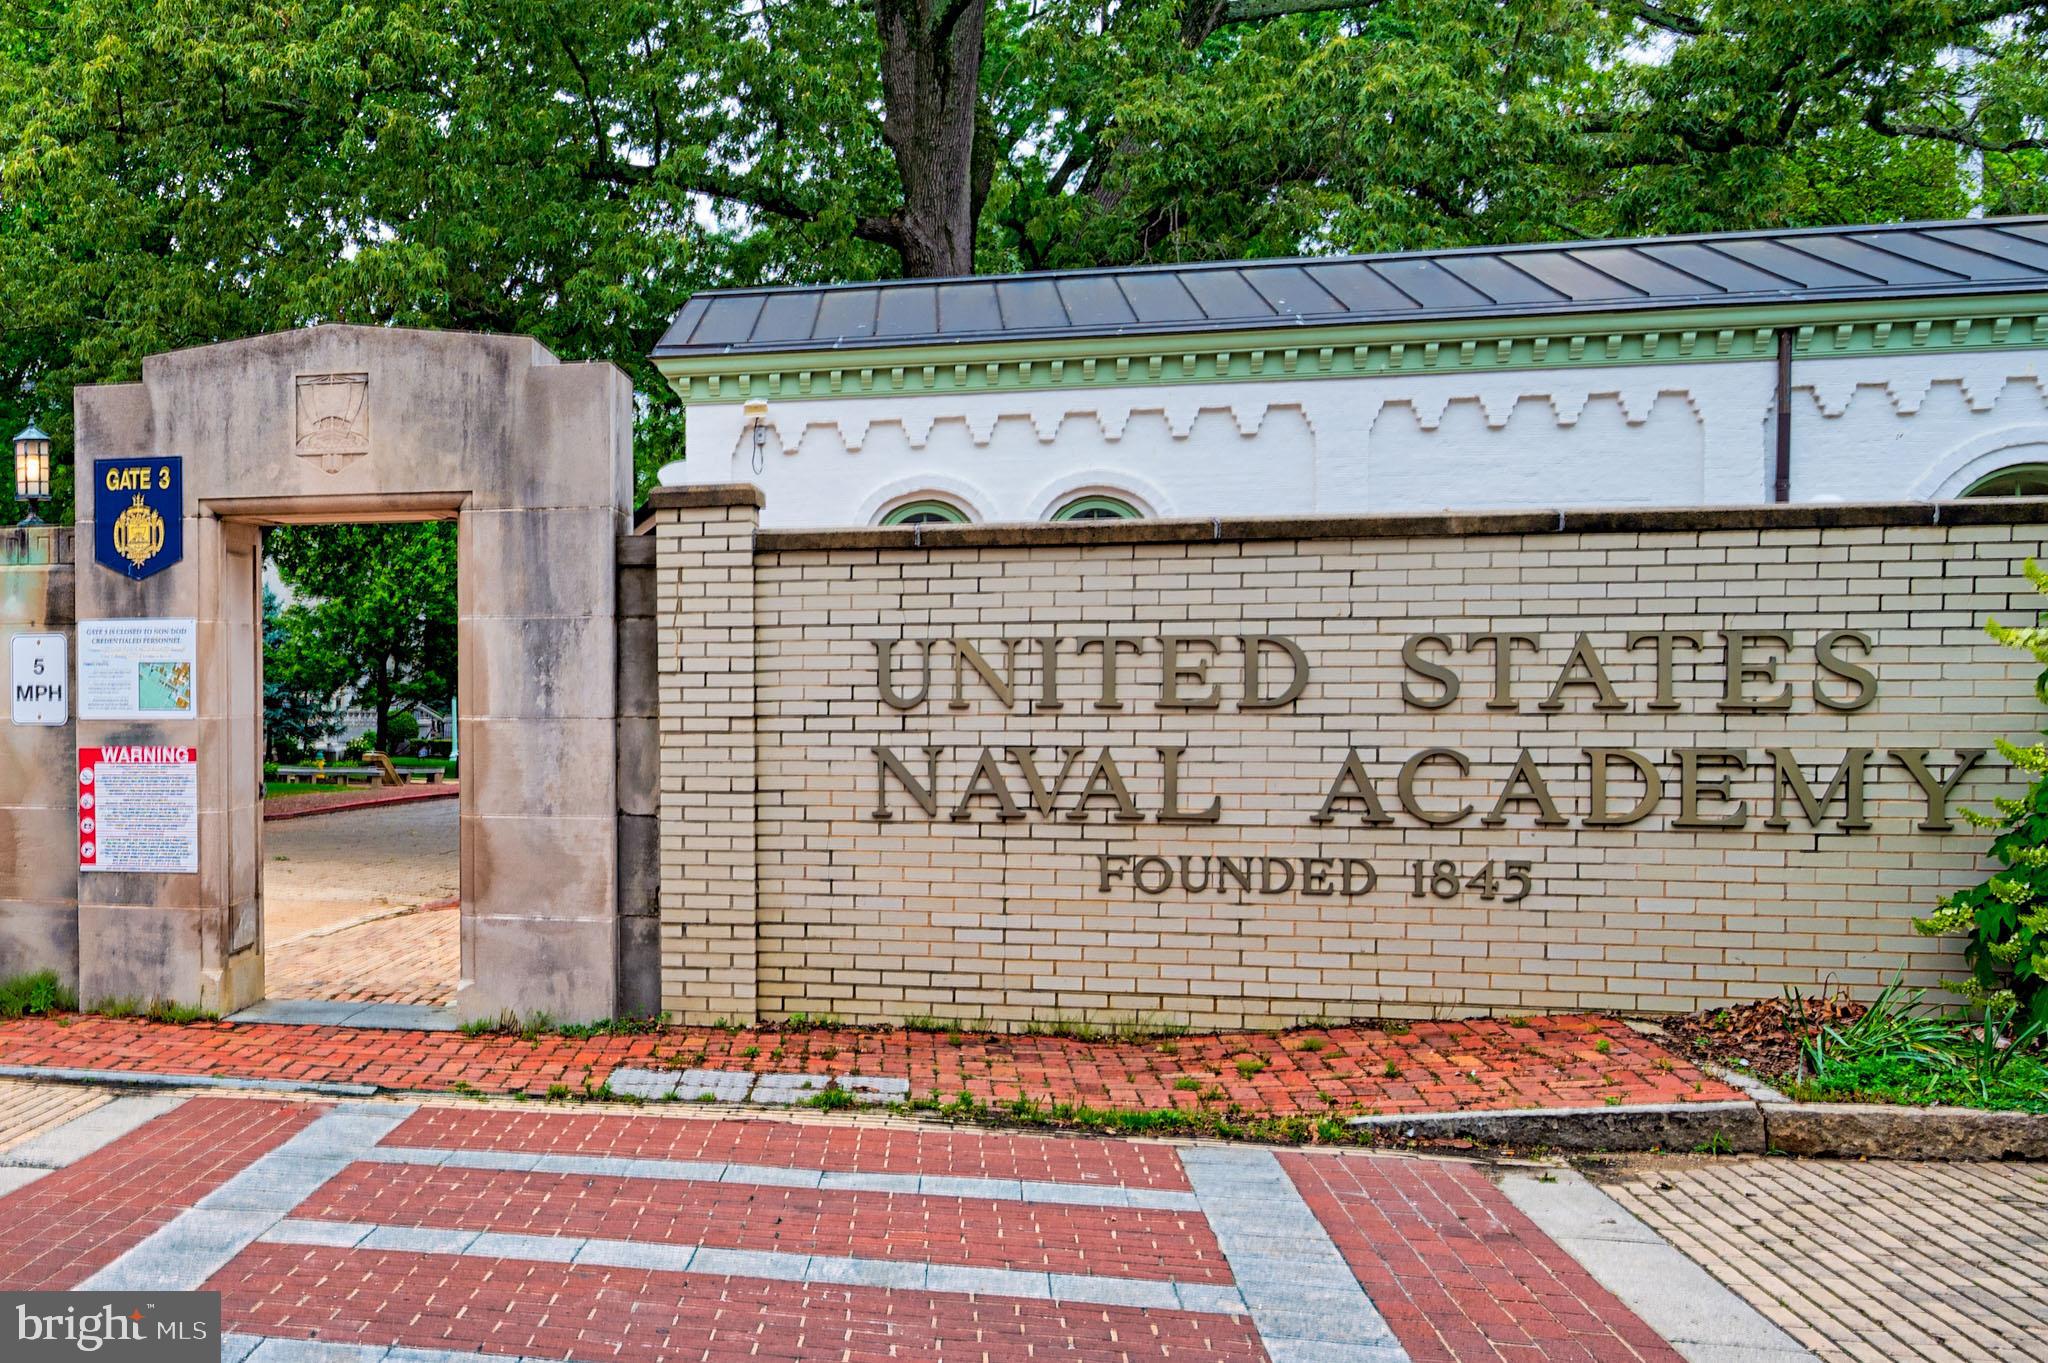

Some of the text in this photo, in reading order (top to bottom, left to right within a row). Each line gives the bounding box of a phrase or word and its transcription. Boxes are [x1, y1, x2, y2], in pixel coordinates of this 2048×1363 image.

[106, 466, 171, 491] GATE 3
[33, 658, 45, 675] 5
[870, 629, 1878, 711] UNITED STATES
[16, 684, 62, 702] MPH
[101, 745, 189, 764] WARNING
[871, 745, 1987, 832] NAVAL ACADEMY
[1098, 855, 1533, 902] FOUNDED 1845
